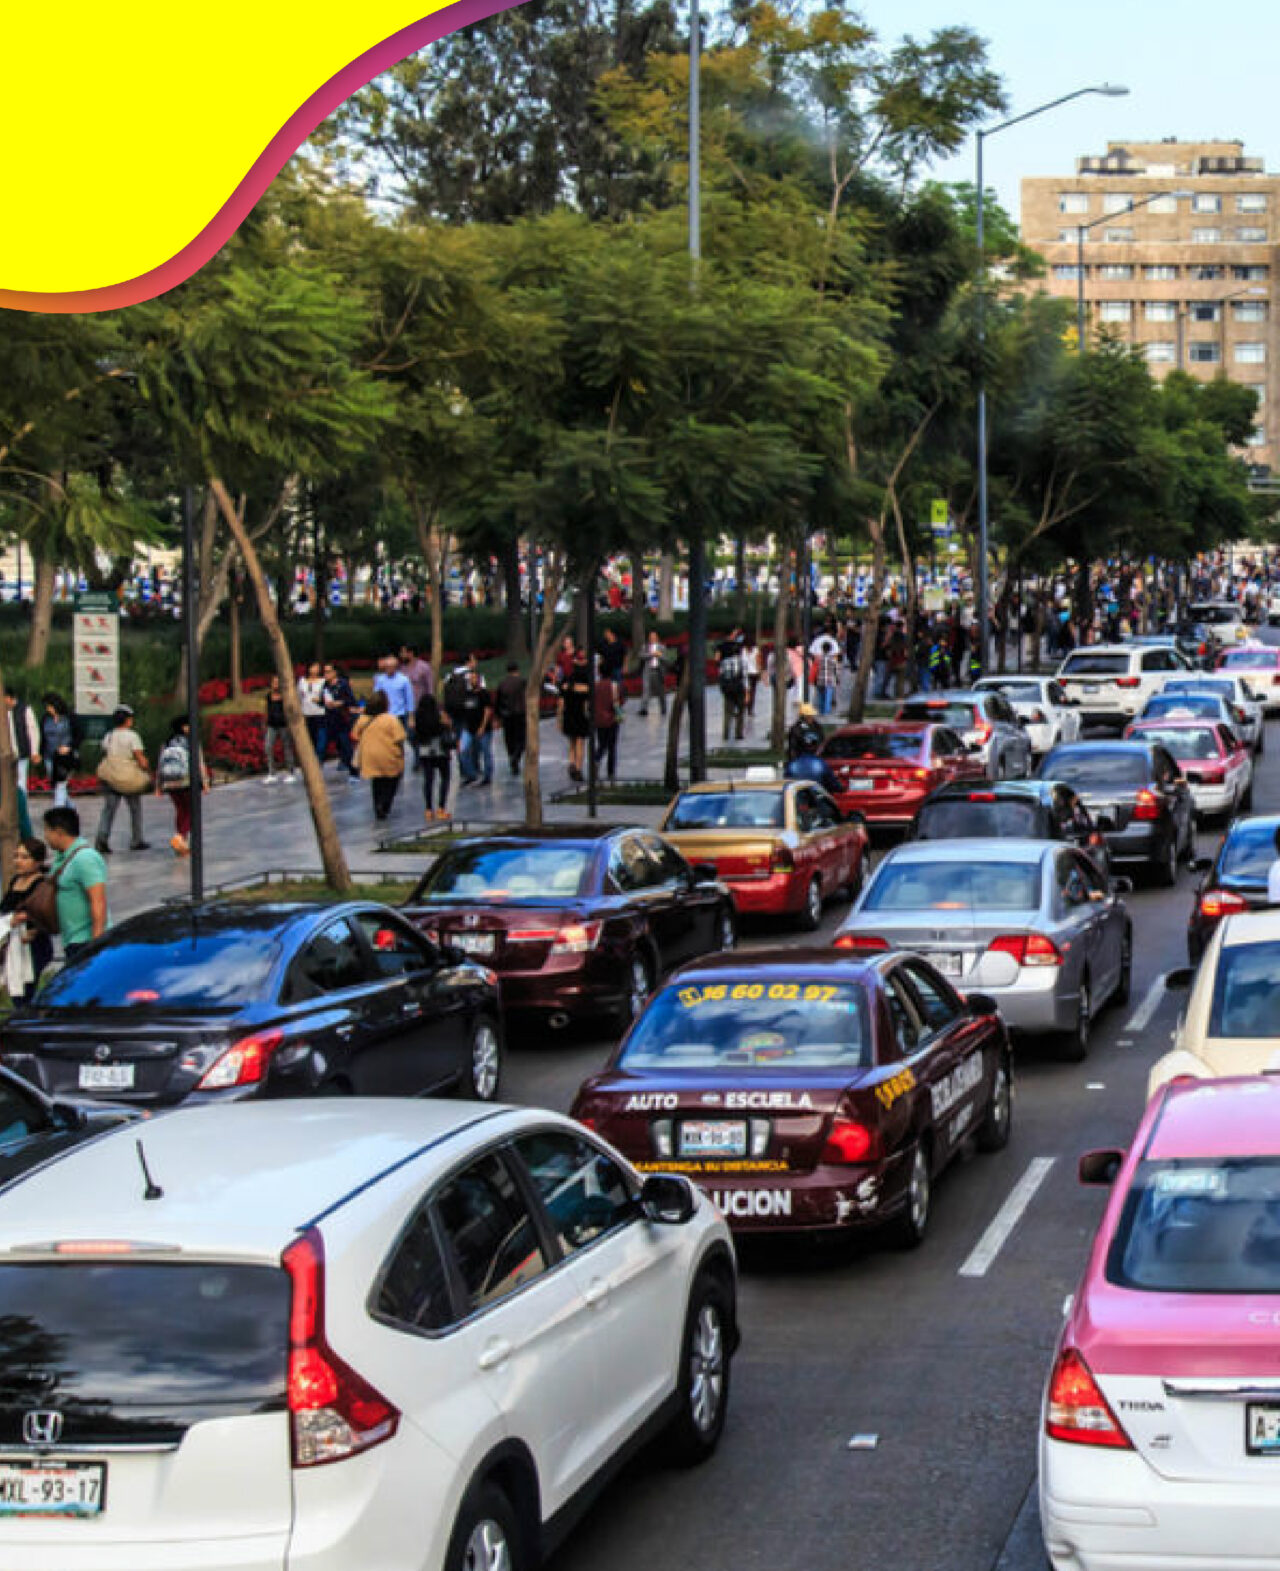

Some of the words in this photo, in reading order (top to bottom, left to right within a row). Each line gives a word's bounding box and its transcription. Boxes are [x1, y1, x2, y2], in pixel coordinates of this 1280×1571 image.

[731, 984, 765, 999] 60
[767, 984, 800, 999] 02
[803, 985, 838, 1002] 97
[626, 1093, 678, 1110] AUTO
[725, 1092, 812, 1108] ESCUELA
